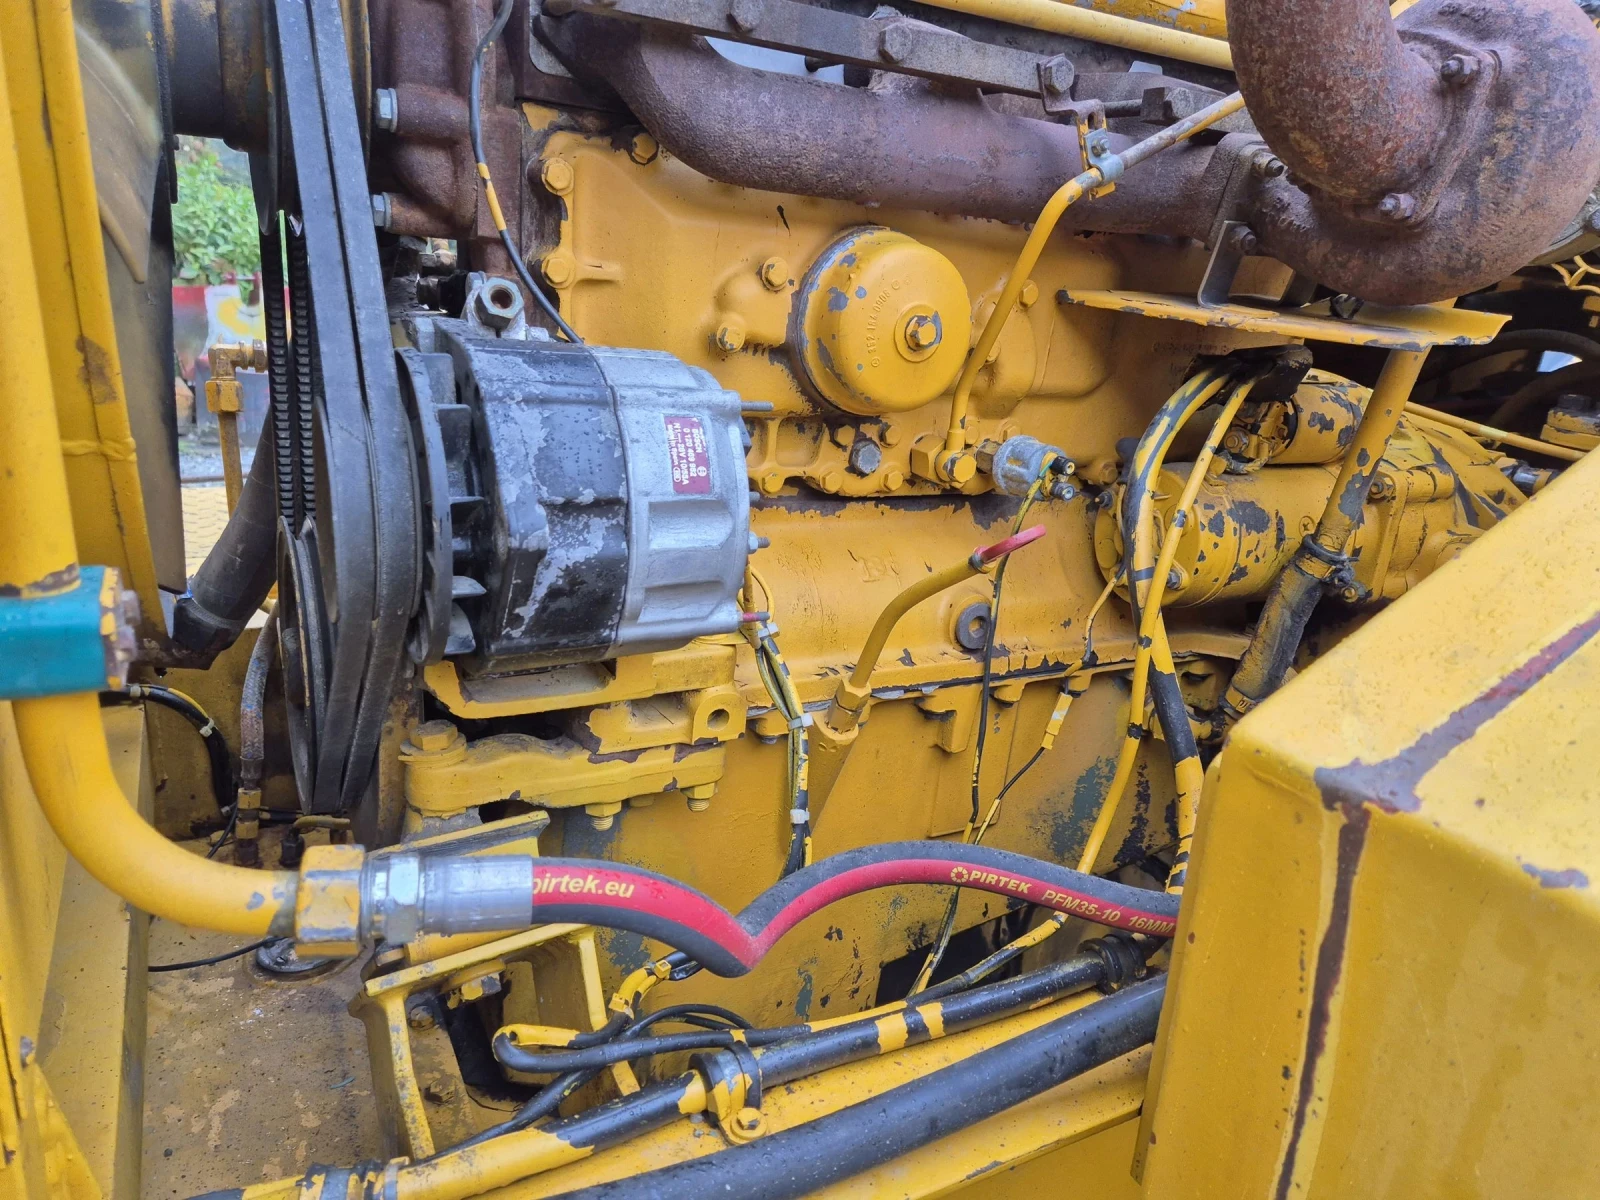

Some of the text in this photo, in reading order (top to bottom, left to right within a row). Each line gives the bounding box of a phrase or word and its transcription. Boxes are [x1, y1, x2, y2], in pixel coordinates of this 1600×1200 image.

[692, 428, 703, 453] BOSCH
[970, 870, 1033, 894] PIRTEK
[1041, 889, 1121, 922] PFM35-10
